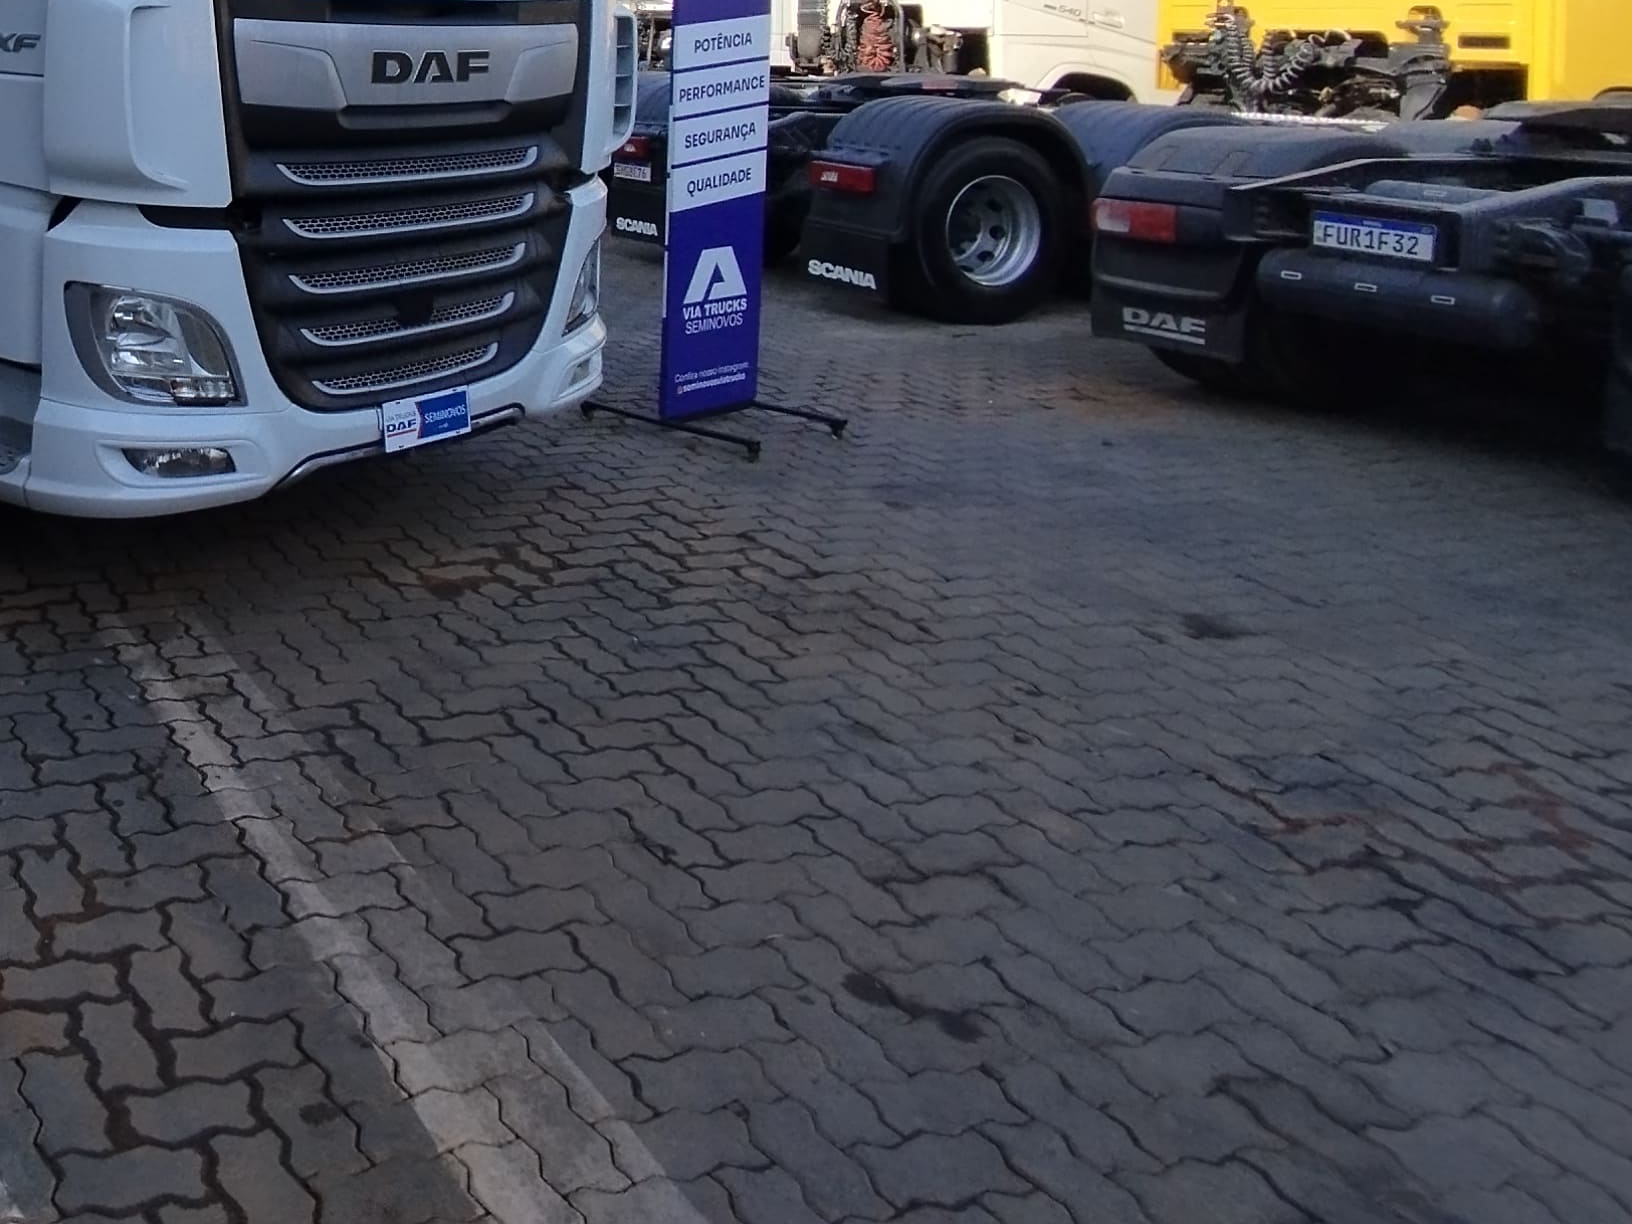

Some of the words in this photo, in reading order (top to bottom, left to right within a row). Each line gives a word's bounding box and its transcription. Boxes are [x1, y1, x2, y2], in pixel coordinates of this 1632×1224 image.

[694, 32, 752, 53] POTÊNCIA
[371, 50, 490, 84] DAF
[679, 75, 765, 102] PERFORMANCE
[684, 122, 756, 149] SEGURANÇA
[686, 167, 752, 196] QUALIDADE
[615, 216, 658, 237] SCANIA
[1323, 225, 1419, 255] FUR1F32
[807, 259, 877, 290] SCANIA
[683, 306, 702, 320] VIA
[704, 298, 747, 317] TRUCKS
[1123, 307, 1206, 333] DAF
[685, 313, 743, 335] SEMINOVOS
[386, 418, 417, 433] DAF
